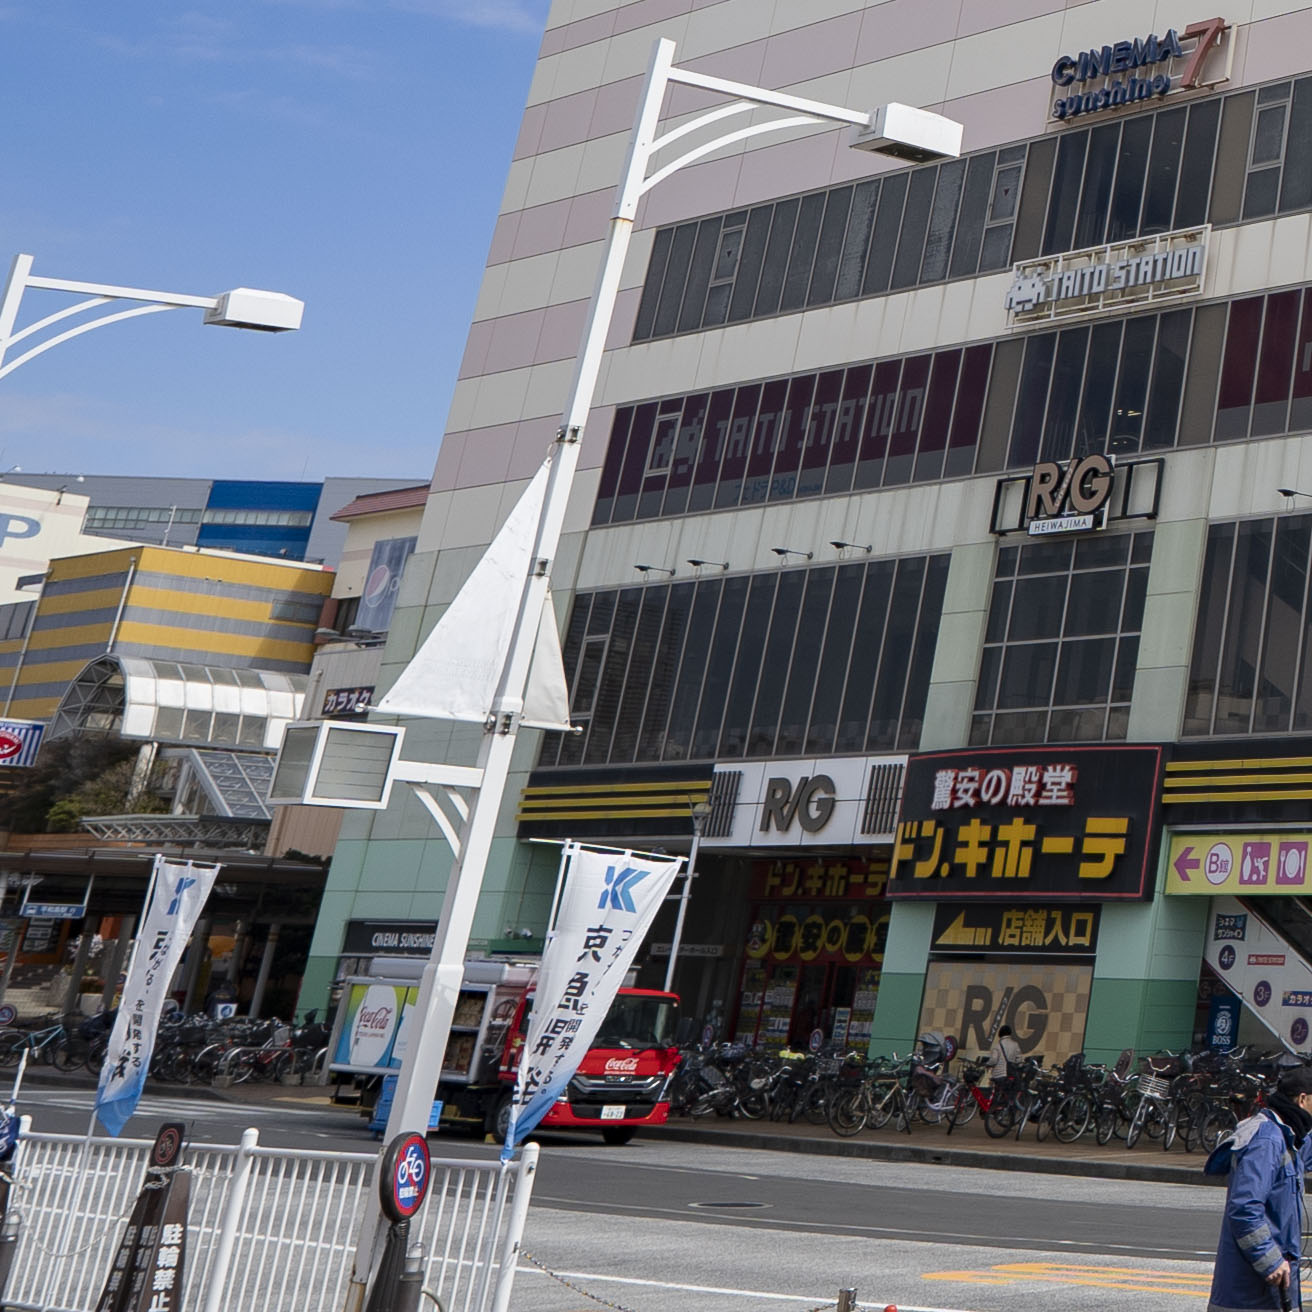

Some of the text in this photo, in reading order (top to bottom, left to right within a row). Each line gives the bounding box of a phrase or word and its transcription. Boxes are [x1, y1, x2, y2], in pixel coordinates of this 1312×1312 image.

[1051, 17, 1225, 88] CINEMA 7
[1051, 244, 1205, 301] TAITO STATION
[714, 389, 924, 462] TAITO STATION
[1034, 518, 1087, 532] HEIWAJIMA
[930, 763, 1077, 812] 驚安の殿堂
[372, 933, 399, 946] CINEMA
[998, 908, 1094, 946] 店舗入口
